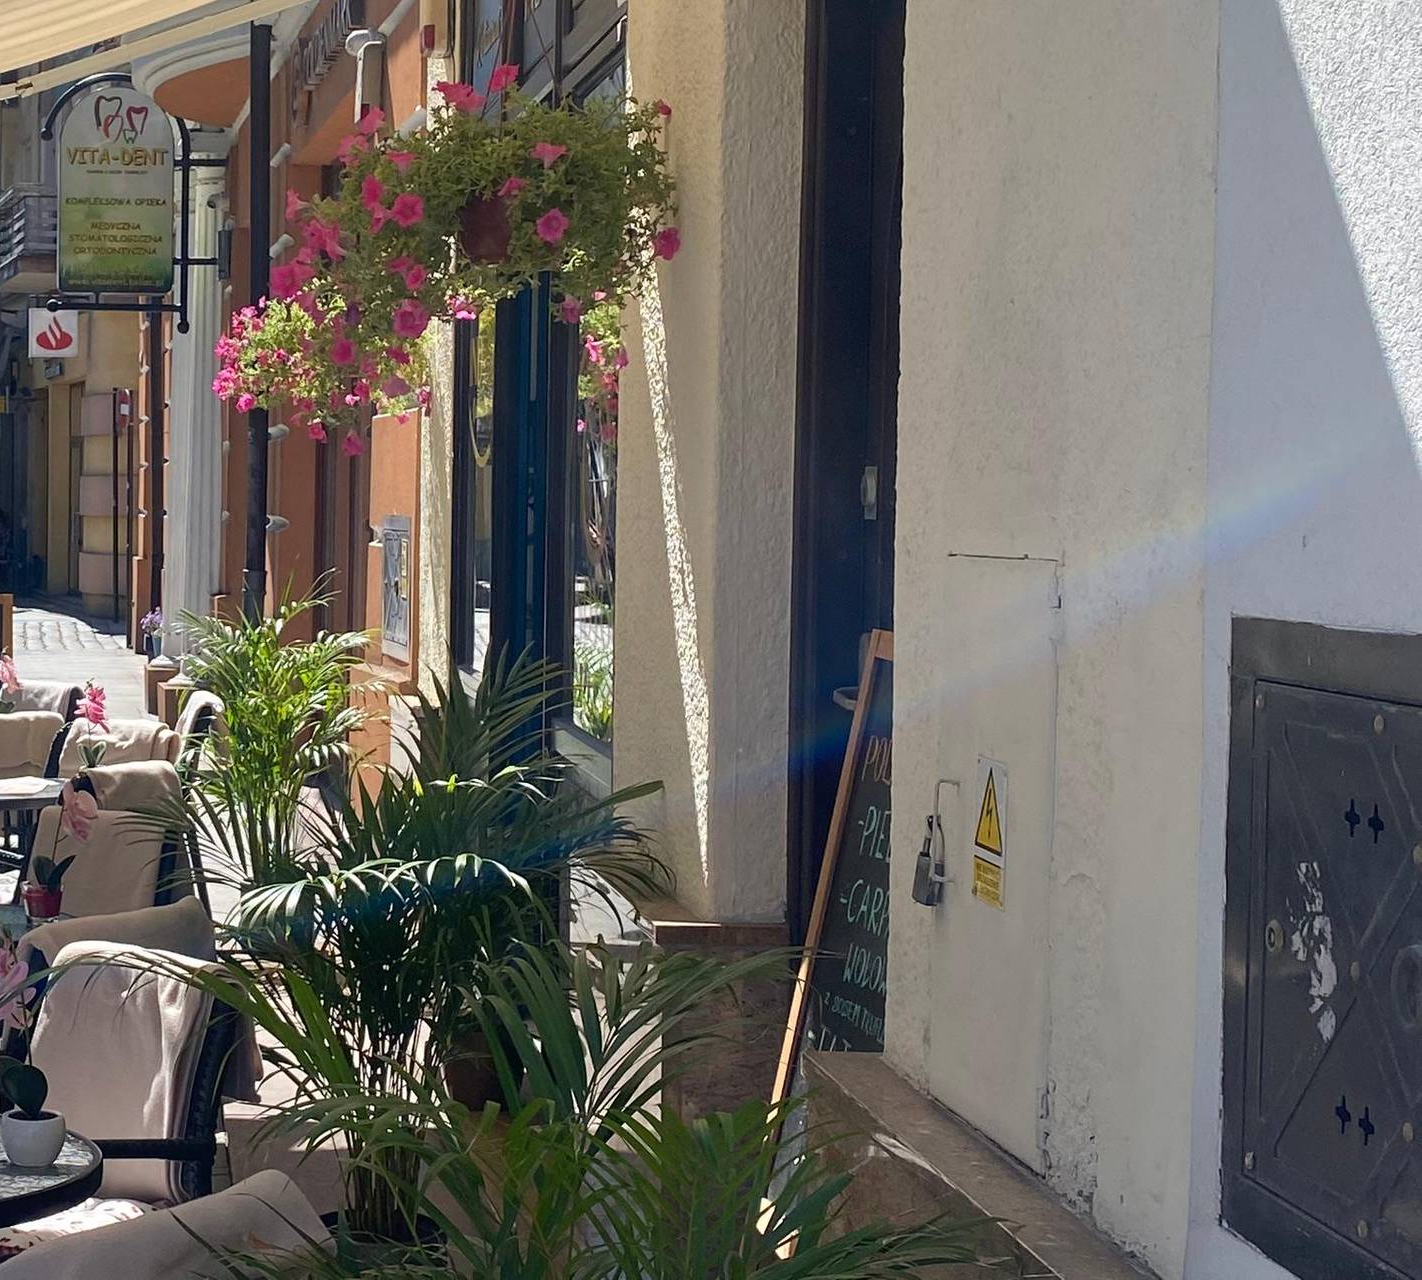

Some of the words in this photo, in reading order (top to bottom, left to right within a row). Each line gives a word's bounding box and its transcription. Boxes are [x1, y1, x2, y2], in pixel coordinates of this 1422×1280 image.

[66, 146, 169, 167] VITA-DENT
[65, 197, 131, 206] KOMPLEKSOWA
[134, 198, 167, 207] OPIEKA
[90, 222, 141, 231] MEDYCZNA
[68, 234, 163, 243] STOMATOLOGICZNA
[74, 246, 158, 256] ORTODONTYCZNA
